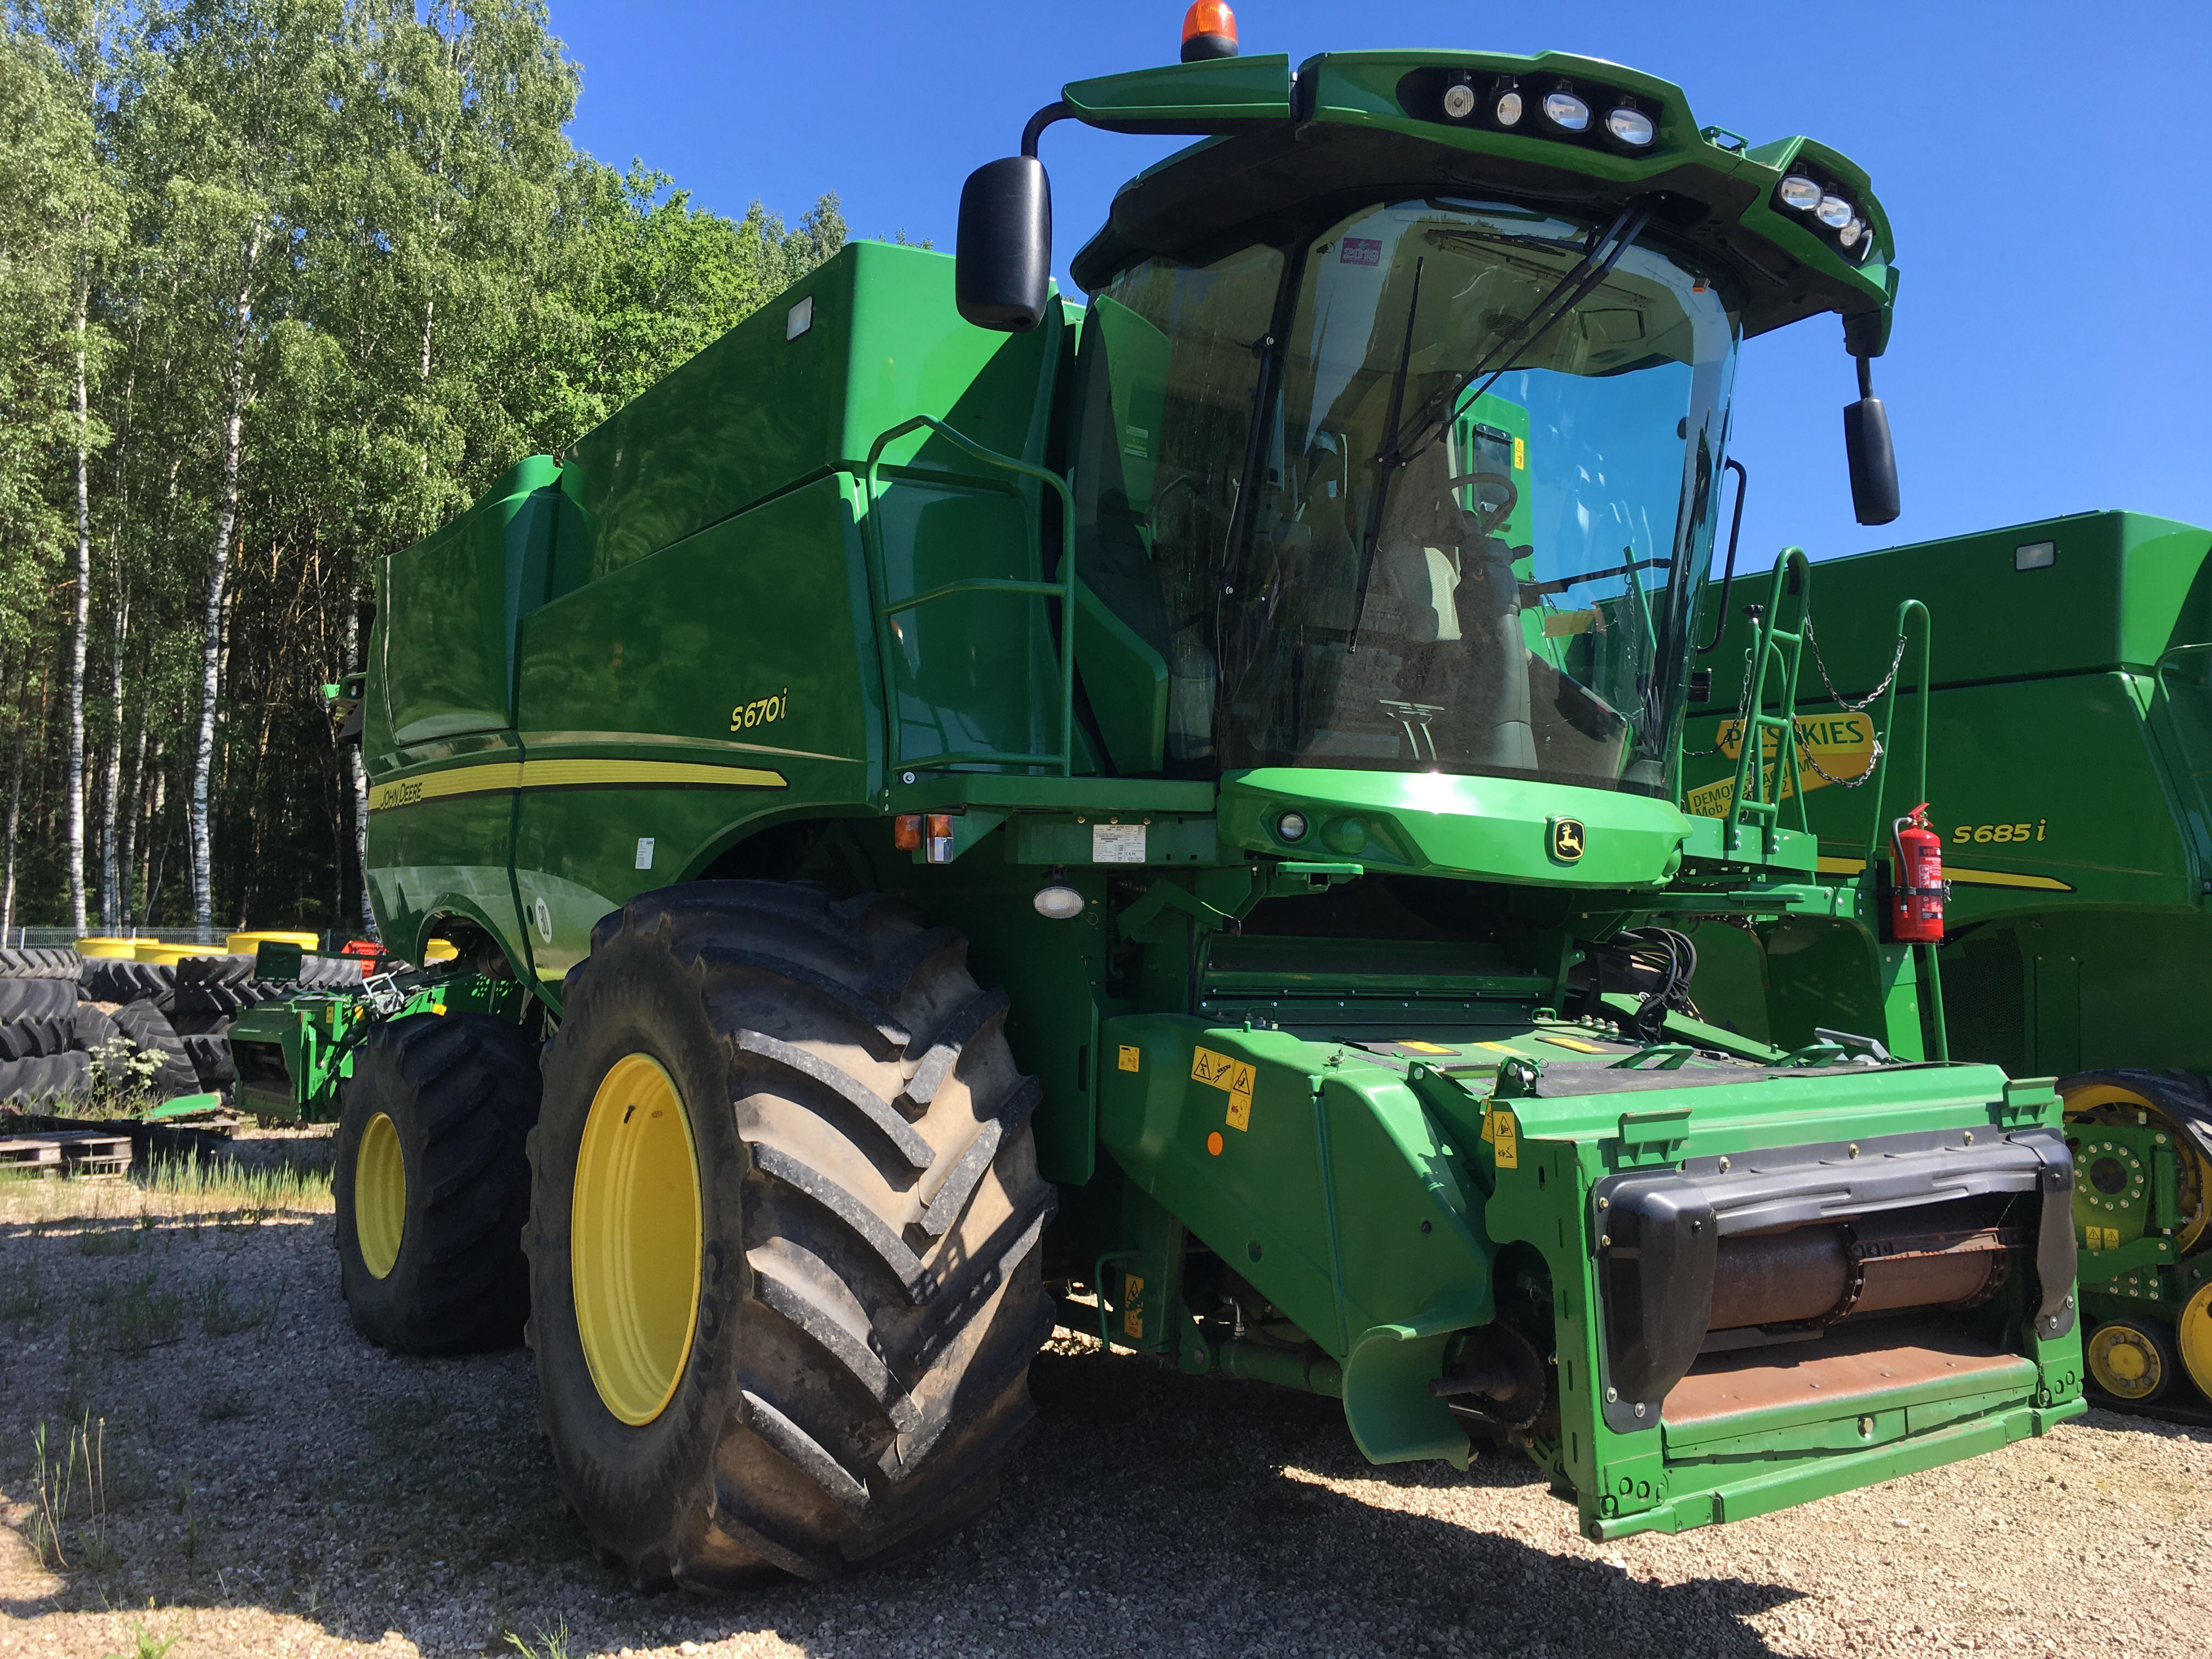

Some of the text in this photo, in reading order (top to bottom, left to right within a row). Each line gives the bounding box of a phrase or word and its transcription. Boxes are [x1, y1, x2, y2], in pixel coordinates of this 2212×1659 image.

[730, 686, 788, 731] S670i
[380, 782, 422, 807] JOHN DEERE
[538, 905, 549, 935] 30
